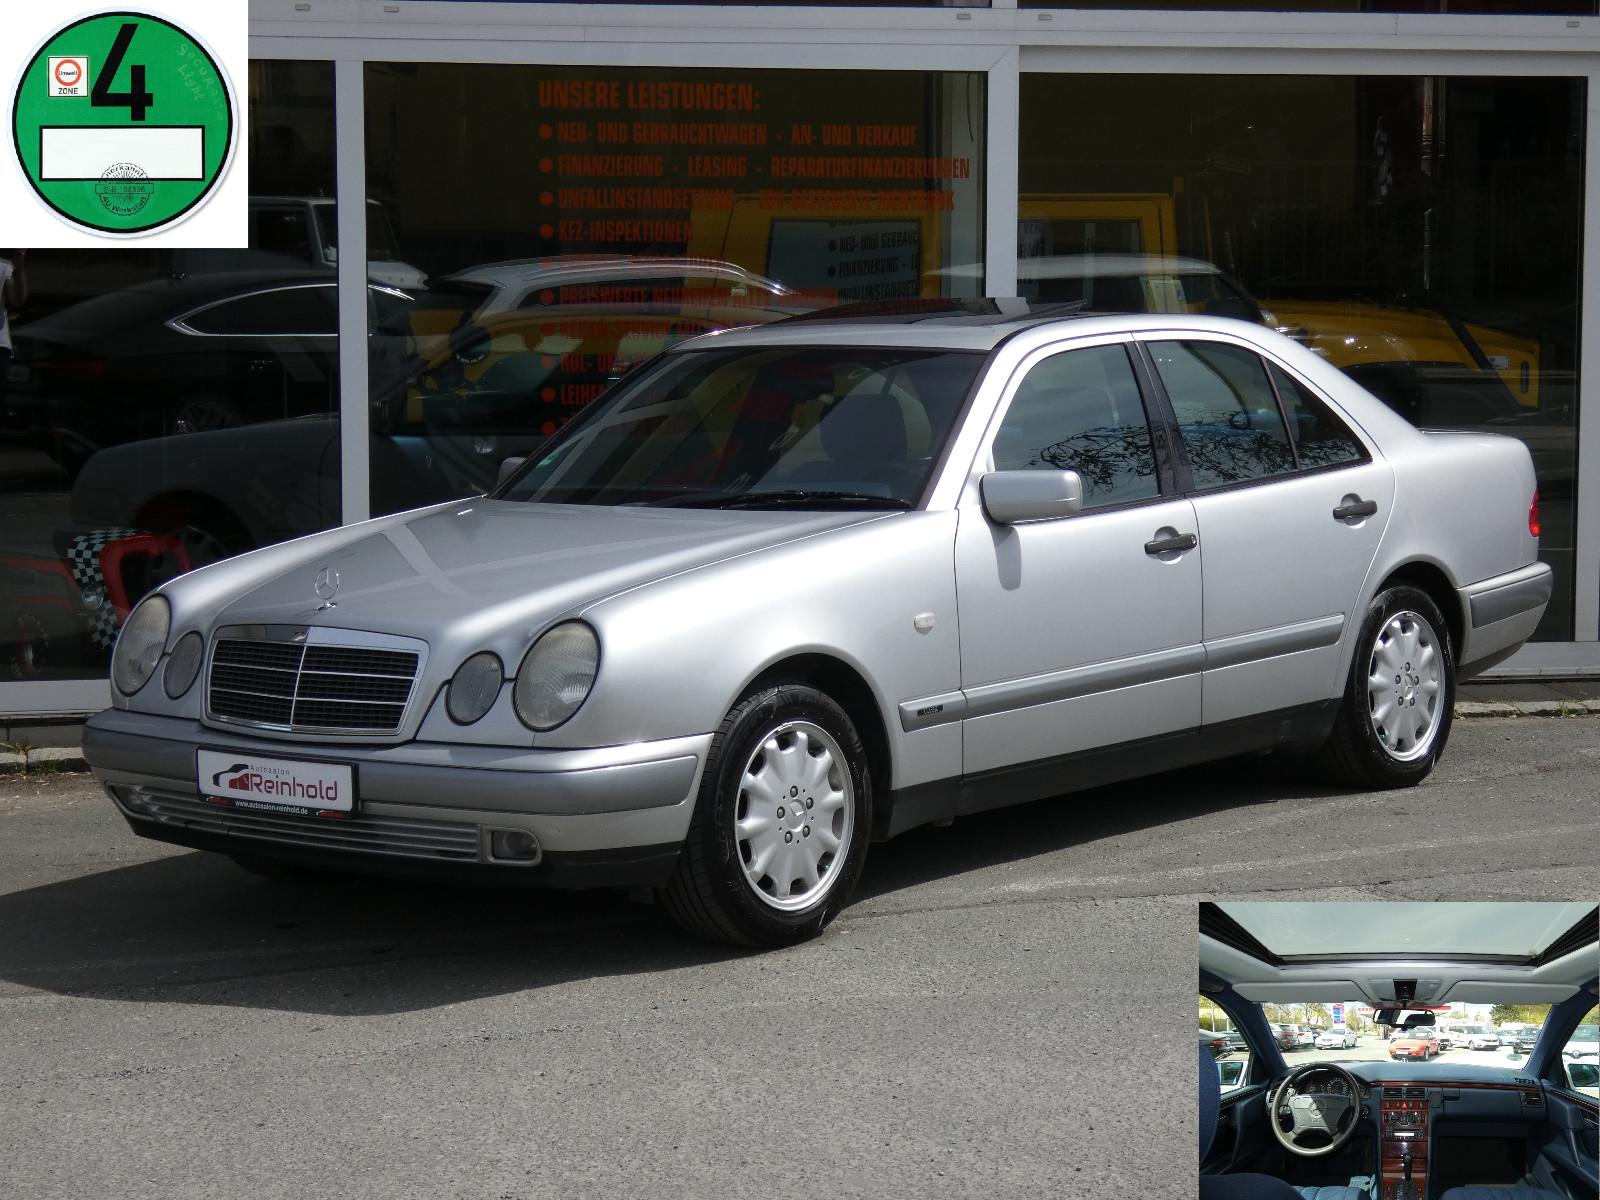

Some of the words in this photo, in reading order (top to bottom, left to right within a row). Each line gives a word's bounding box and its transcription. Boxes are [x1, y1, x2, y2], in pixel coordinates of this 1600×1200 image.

[539, 80, 619, 109] UNSERE
[627, 81, 760, 111] LEISTUNGEN:
[597, 122, 628, 144] UND
[633, 123, 767, 145] GEBRAUCHTWAGEN
[791, 124, 817, 145] AN-
[822, 125, 851, 146] UND
[856, 125, 917, 146] VERKAUF
[559, 155, 663, 177] FINANZIERUNG
[687, 156, 748, 177] LEASING
[771, 157, 970, 179] REPARATURFINANZIERUNGEN
[250, 765, 290, 776] Autosalon
[251, 773, 338, 801] Reinhold
[235, 800, 308, 815] www.autosalon-reinhold.de
